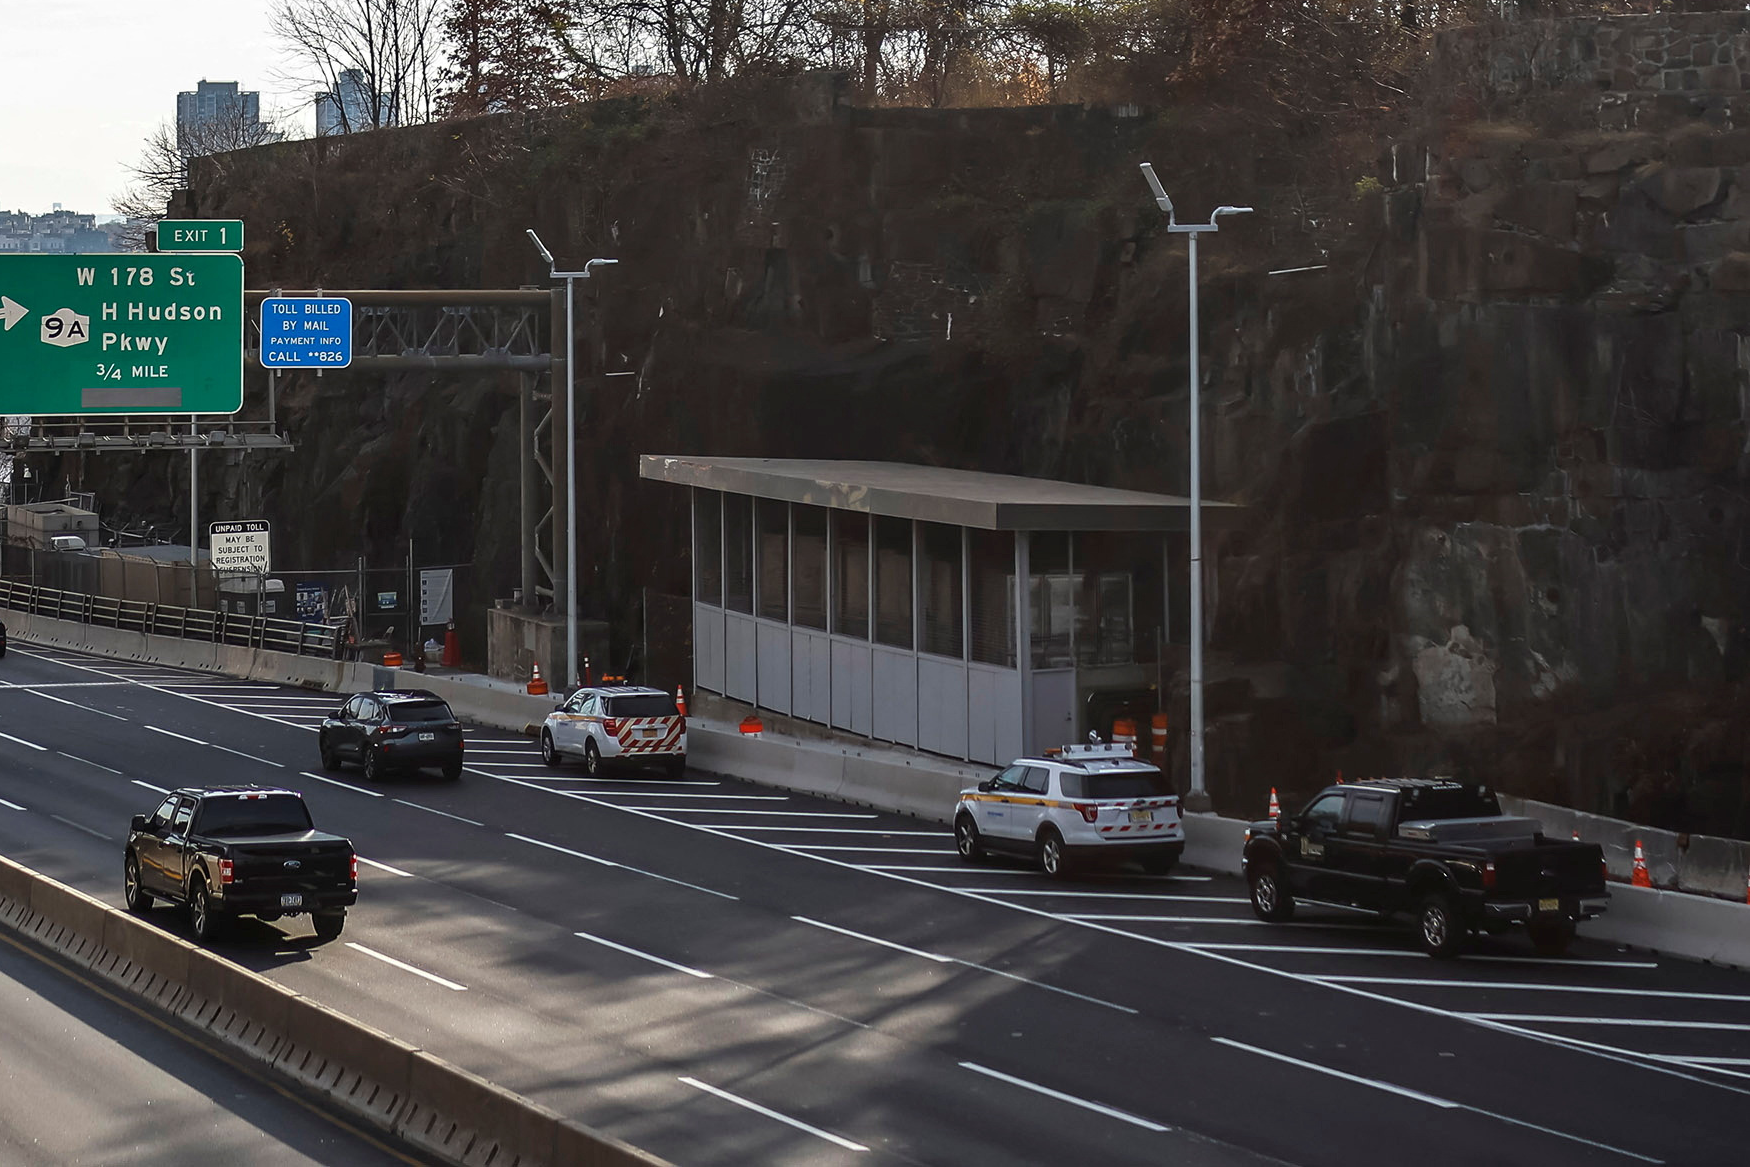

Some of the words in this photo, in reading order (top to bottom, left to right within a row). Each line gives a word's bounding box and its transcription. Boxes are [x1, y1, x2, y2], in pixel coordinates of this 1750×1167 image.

[174, 229, 208, 242] EXIT
[219, 227, 226, 245] 1
[76, 267, 96, 286] W
[110, 267, 154, 286] 178
[169, 267, 196, 286] St
[102, 302, 117, 321] H
[128, 302, 222, 321] Hudson
[272, 304, 298, 314] TOLL
[304, 304, 341, 314] BILLED
[45, 317, 86, 339] 9A
[282, 320, 297, 331] BY
[304, 320, 329, 331] MAIL
[102, 333, 169, 356] Pkwy
[270, 337, 315, 345] PAYMENT
[320, 337, 341, 345] INFO
[268, 351, 301, 362] CALL
[132, 366, 169, 378] MILE
[215, 524, 243, 532] UNPAID
[246, 523, 264, 531] TOLL
[218, 546, 249, 554] SUBJECT
[216, 555, 265, 564] REGISTRATION
